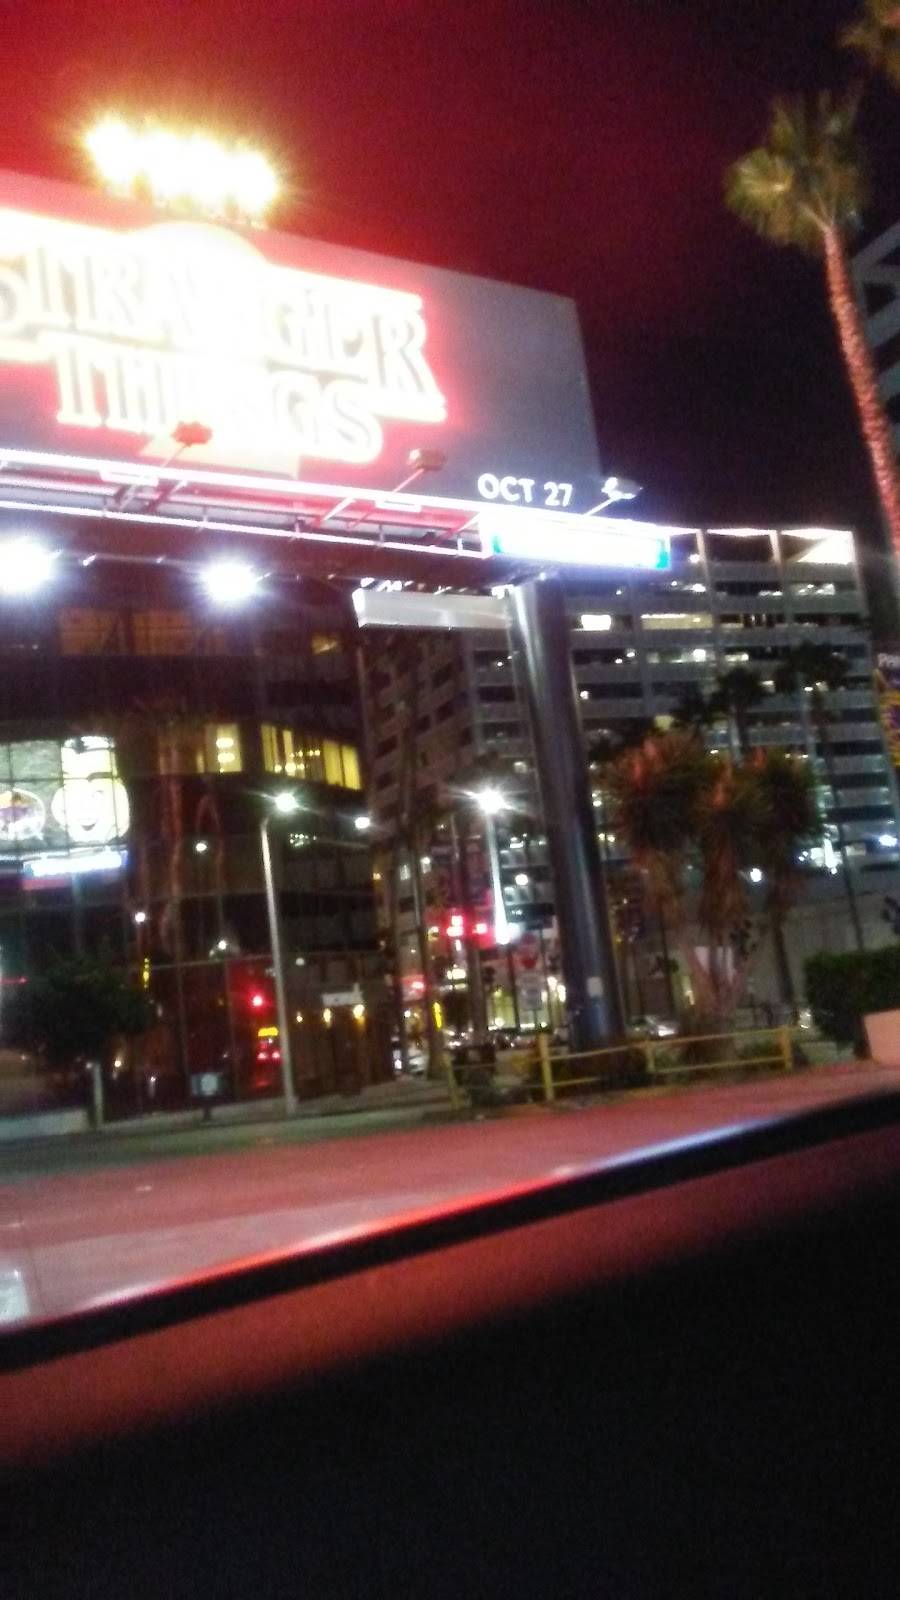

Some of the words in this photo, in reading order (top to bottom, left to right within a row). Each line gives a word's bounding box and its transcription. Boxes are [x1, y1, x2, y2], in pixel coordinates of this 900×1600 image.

[0, 218, 446, 422] TRAGER
[55, 345, 383, 462] THGS
[478, 473, 535, 503] OCT
[543, 481, 573, 507] 27
